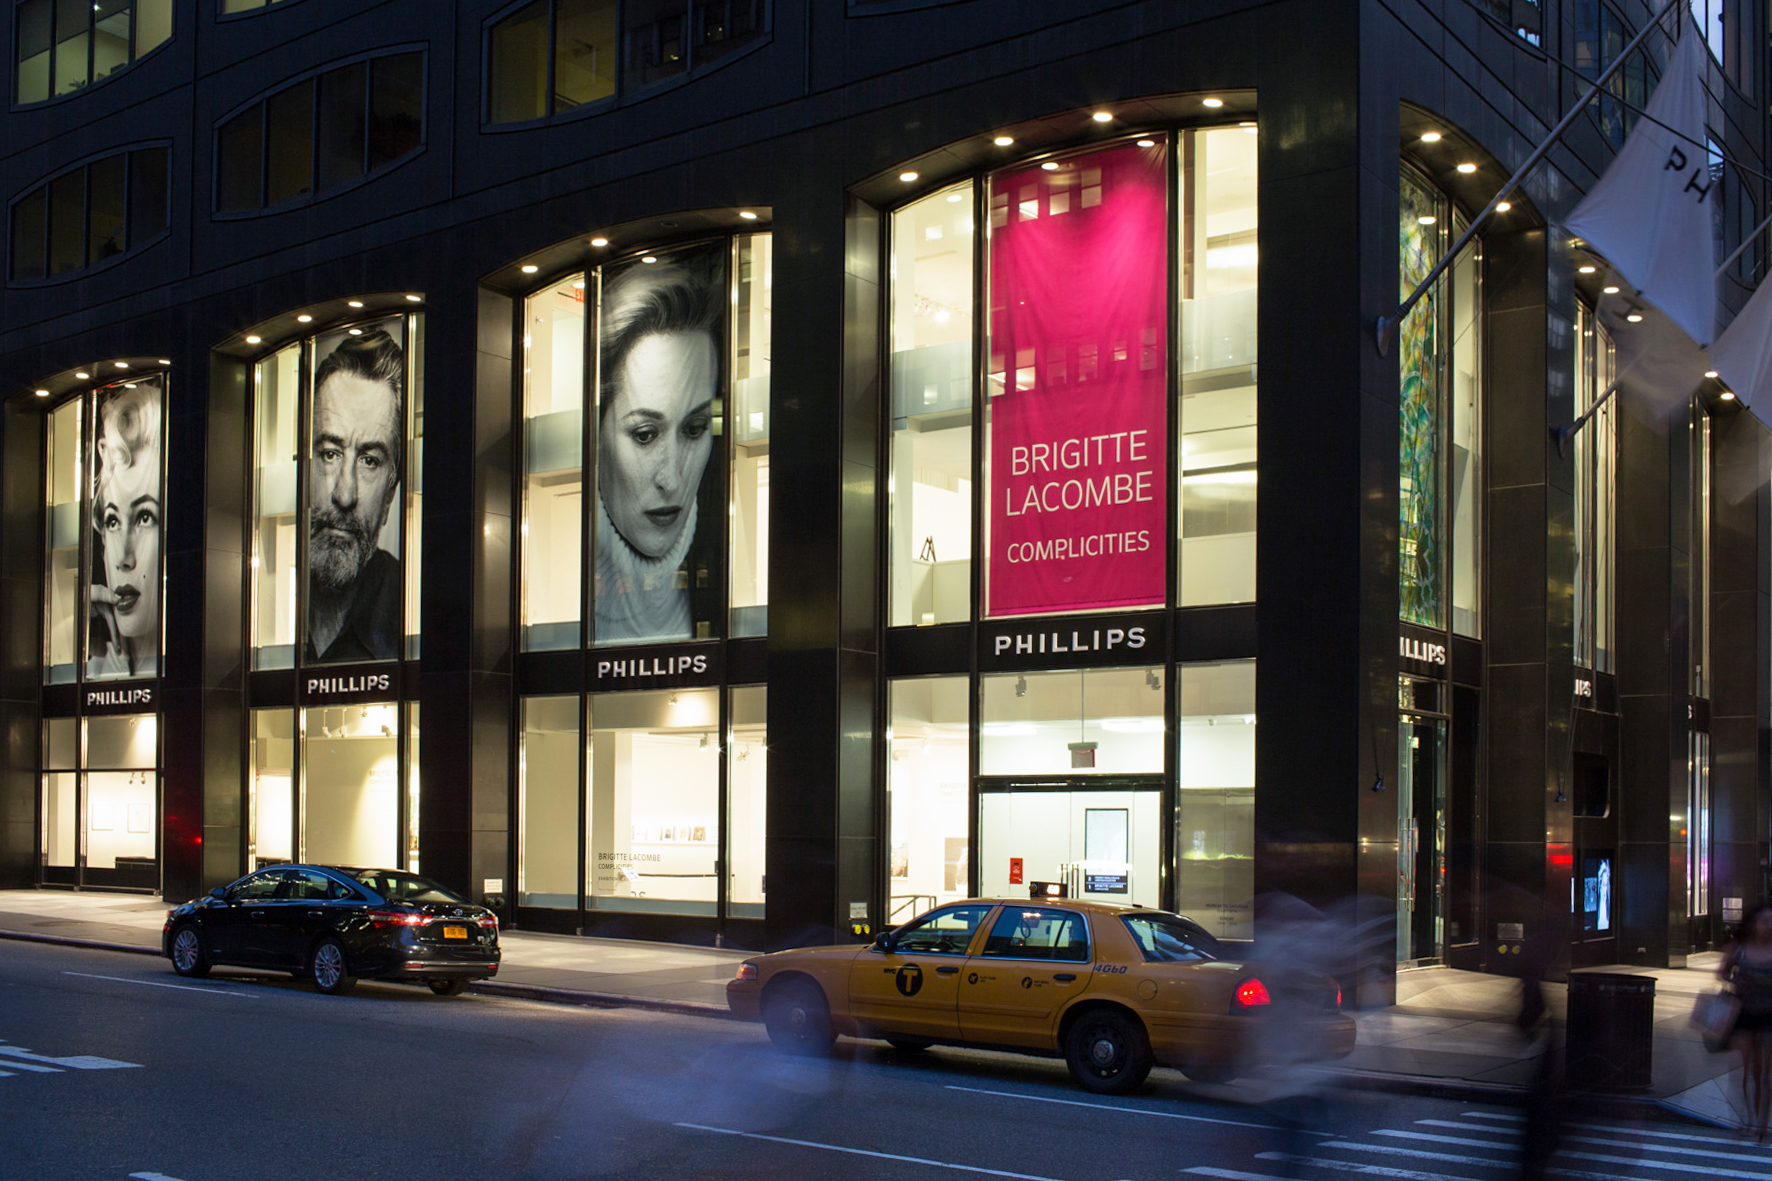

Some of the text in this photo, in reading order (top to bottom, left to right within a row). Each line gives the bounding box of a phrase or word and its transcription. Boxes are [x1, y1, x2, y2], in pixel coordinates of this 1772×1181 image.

[1012, 430, 1148, 476] BRIGITTE
[1006, 470, 1153, 516] LACOMBE
[1007, 530, 1150, 563] COMPLICITIES
[994, 626, 1146, 655] PHILLIPS
[598, 654, 707, 679] PHILLIPS
[86, 688, 152, 706] PHILLIPS
[307, 674, 390, 694] PHILLIPS
[598, 852, 661, 862] BRIGITTE LACOMBE
